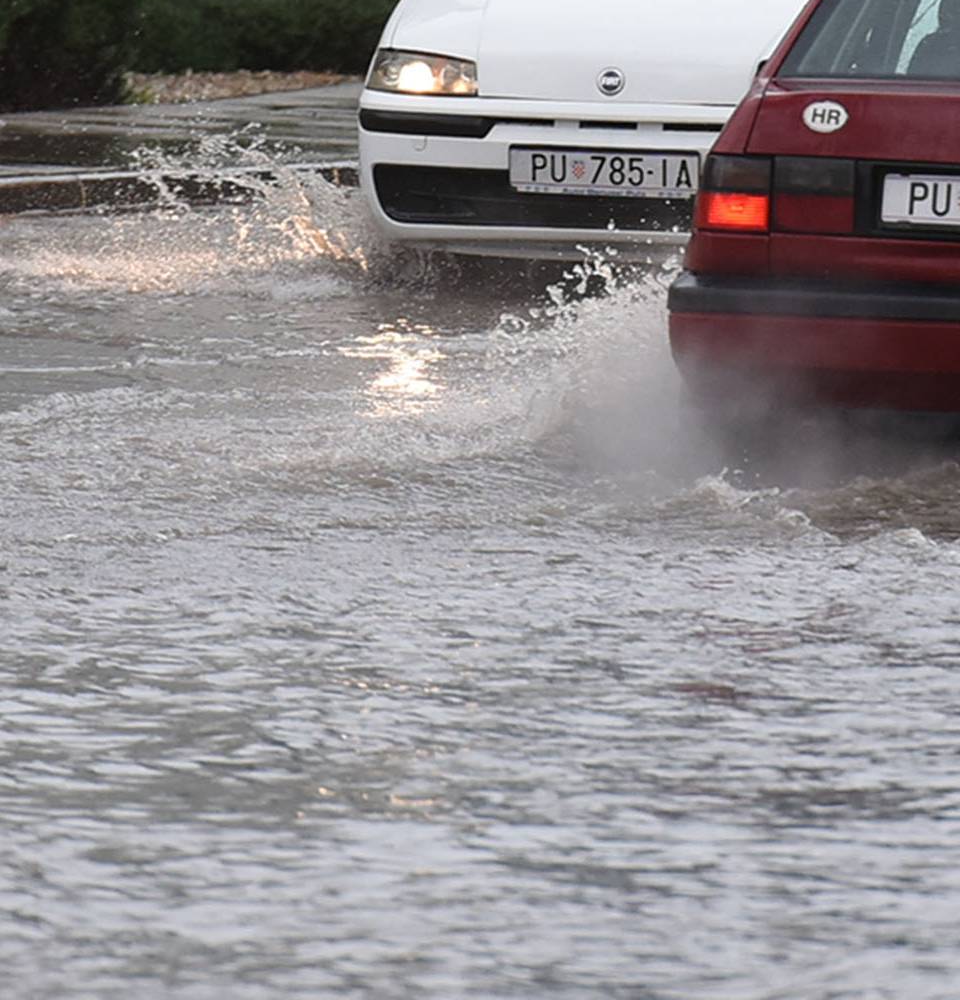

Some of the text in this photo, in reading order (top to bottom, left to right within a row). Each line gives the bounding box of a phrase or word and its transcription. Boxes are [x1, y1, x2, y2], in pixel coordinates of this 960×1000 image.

[811, 107, 841, 125] HR
[531, 153, 692, 188] PU 785-IA
[908, 182, 951, 216] PU
